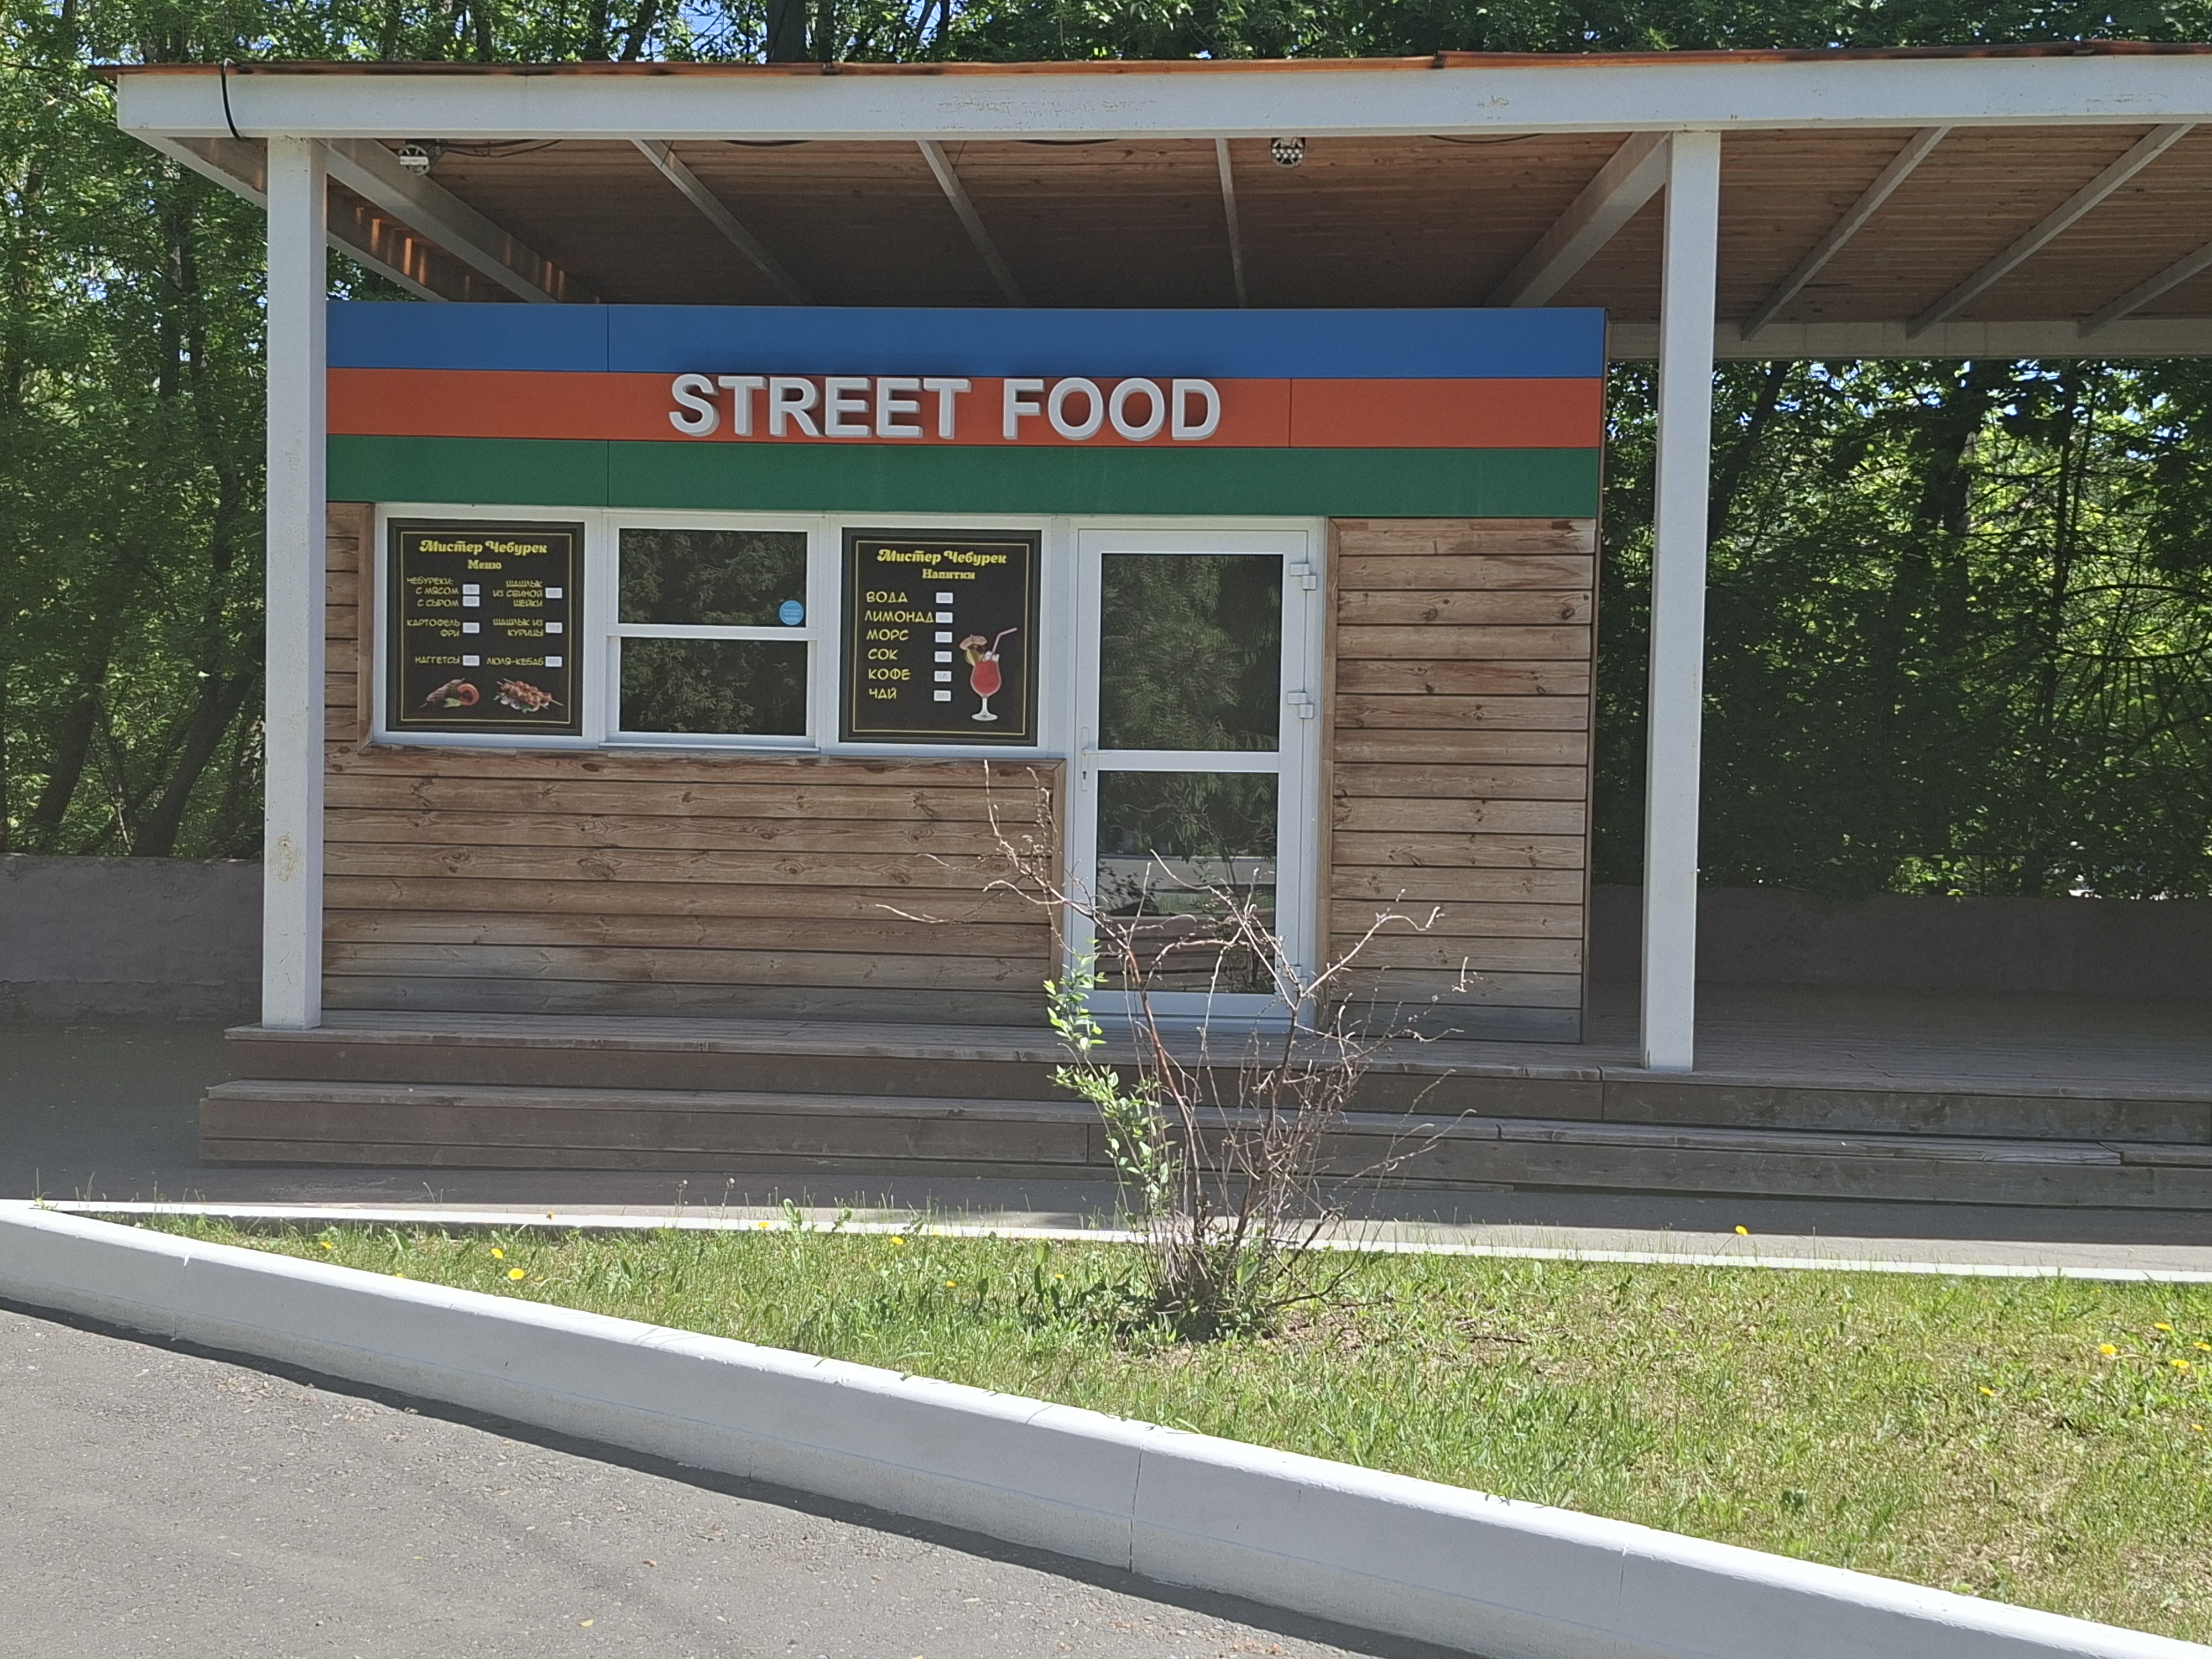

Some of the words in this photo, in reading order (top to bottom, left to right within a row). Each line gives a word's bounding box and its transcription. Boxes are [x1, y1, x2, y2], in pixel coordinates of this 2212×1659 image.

[668, 373, 971, 439] STREET
[1003, 377, 1220, 441] FOOD
[419, 540, 483, 555] Мистер
[485, 540, 547, 556] Чебурек
[877, 549, 941, 565] Мистер
[943, 551, 1006, 566] Чебурек
[467, 560, 502, 570] Меню
[922, 568, 975, 580] Напитки
[866, 591, 907, 602] ВОДА
[865, 611, 935, 623] ЛИМОНАД
[867, 629, 909, 640] МОРС
[868, 649, 898, 660] СОК
[487, 657, 544, 665] ЛЮЛЯ-КЕБАБ
[868, 669, 911, 680] КОФЕ
[869, 687, 896, 699] ЧАЙ
